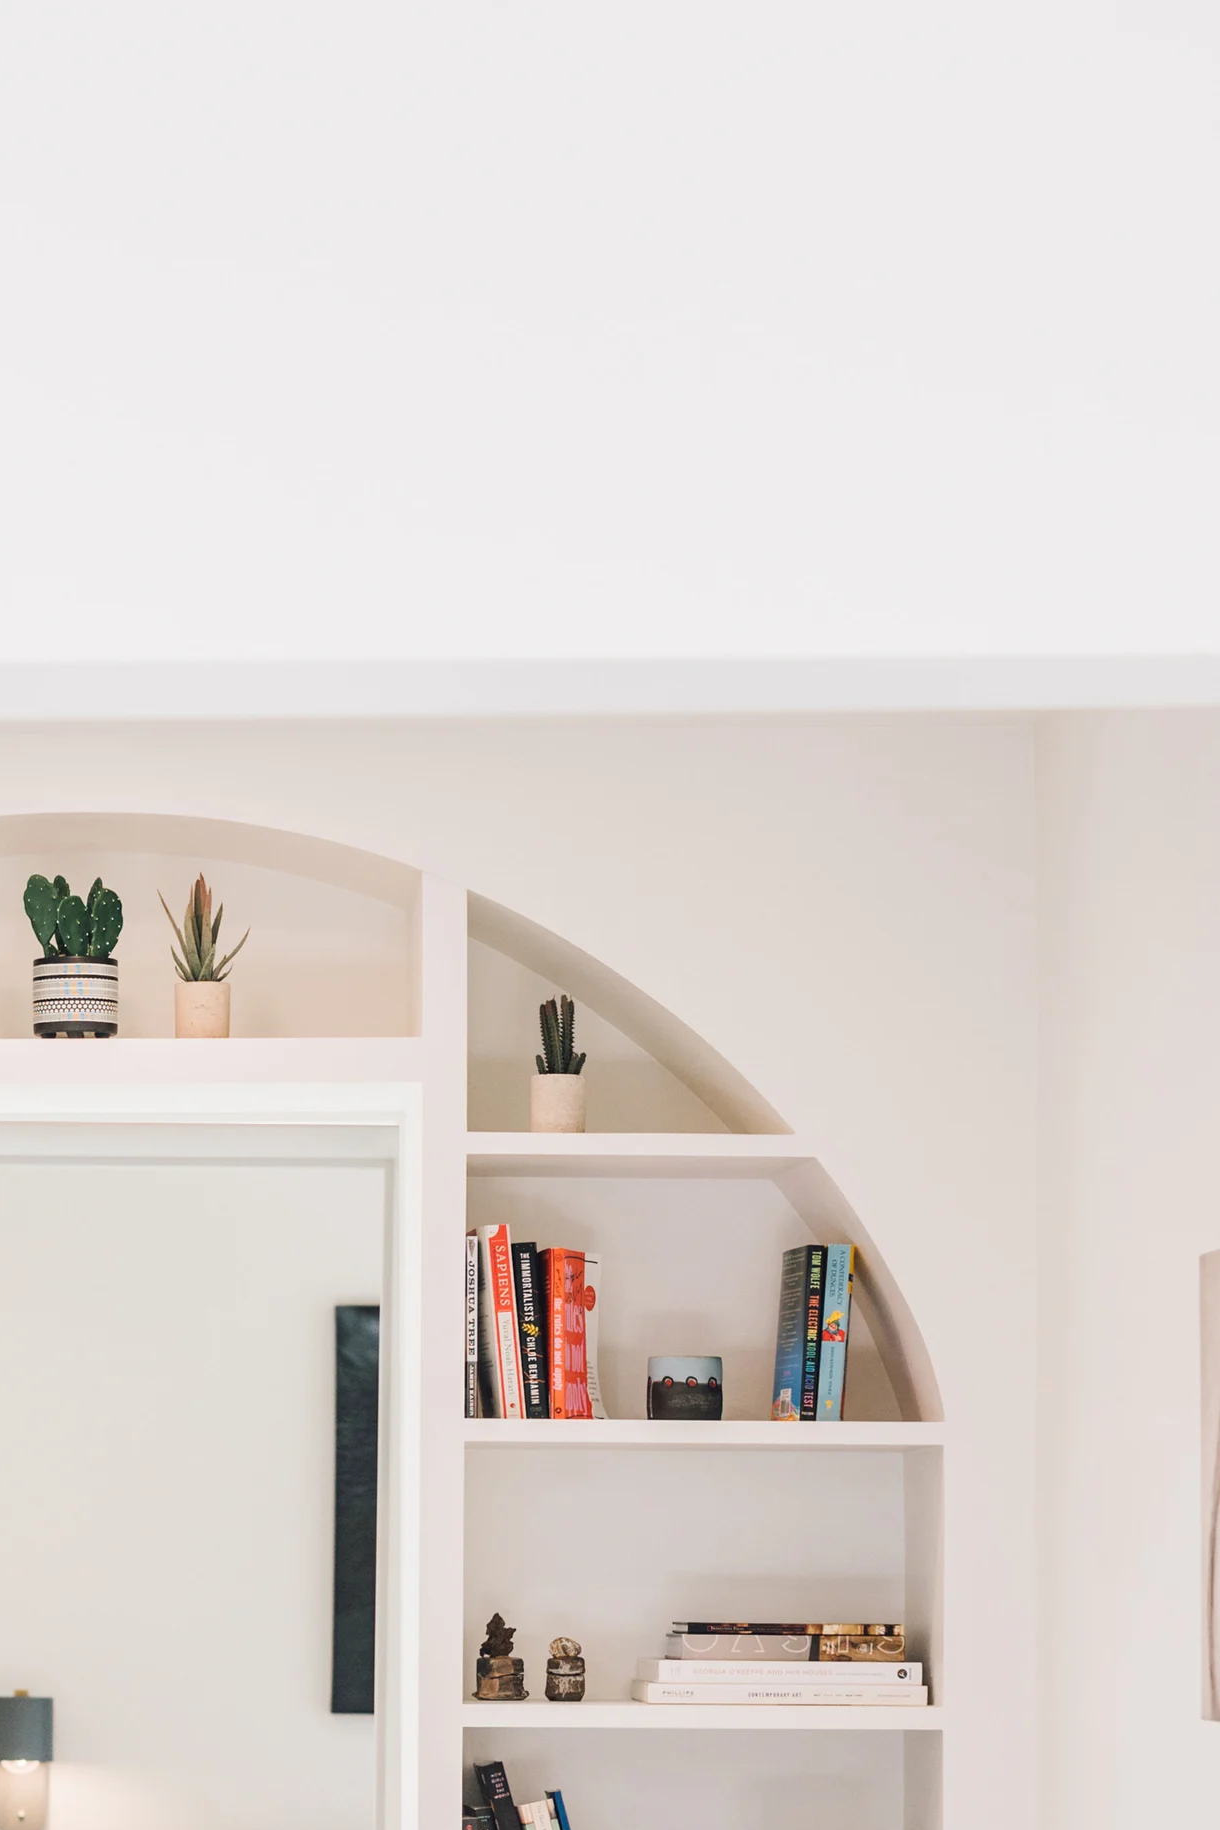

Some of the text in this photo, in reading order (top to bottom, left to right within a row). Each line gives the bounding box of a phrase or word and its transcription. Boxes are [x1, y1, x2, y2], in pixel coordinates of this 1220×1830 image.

[812, 1251, 822, 1265] TOM
[495, 1245, 510, 1306] SAPIENS
[810, 1267, 821, 1289] WOLFE
[829, 1259, 837, 1297] OF DUNCES
[836, 1256, 846, 1306] CONFEDERACY
[520, 1260, 534, 1322] IMMORTALISTS
[808, 1295, 820, 1308] THE
[468, 1260, 476, 1356] JOSHUA TREE
[554, 1298, 562, 1312] the
[554, 1314, 562, 1335] rules
[808, 1310, 819, 1340] ELECTRIC
[554, 1338, 563, 1348] do
[502, 1320, 515, 1396] Yuval Noah Harari
[554, 1351, 563, 1365] not
[526, 1336, 540, 1404] CHLOE BENJAMIN
[552, 1368, 562, 1391] apply
[804, 1374, 815, 1390] ACID
[803, 1392, 814, 1408] TEST
